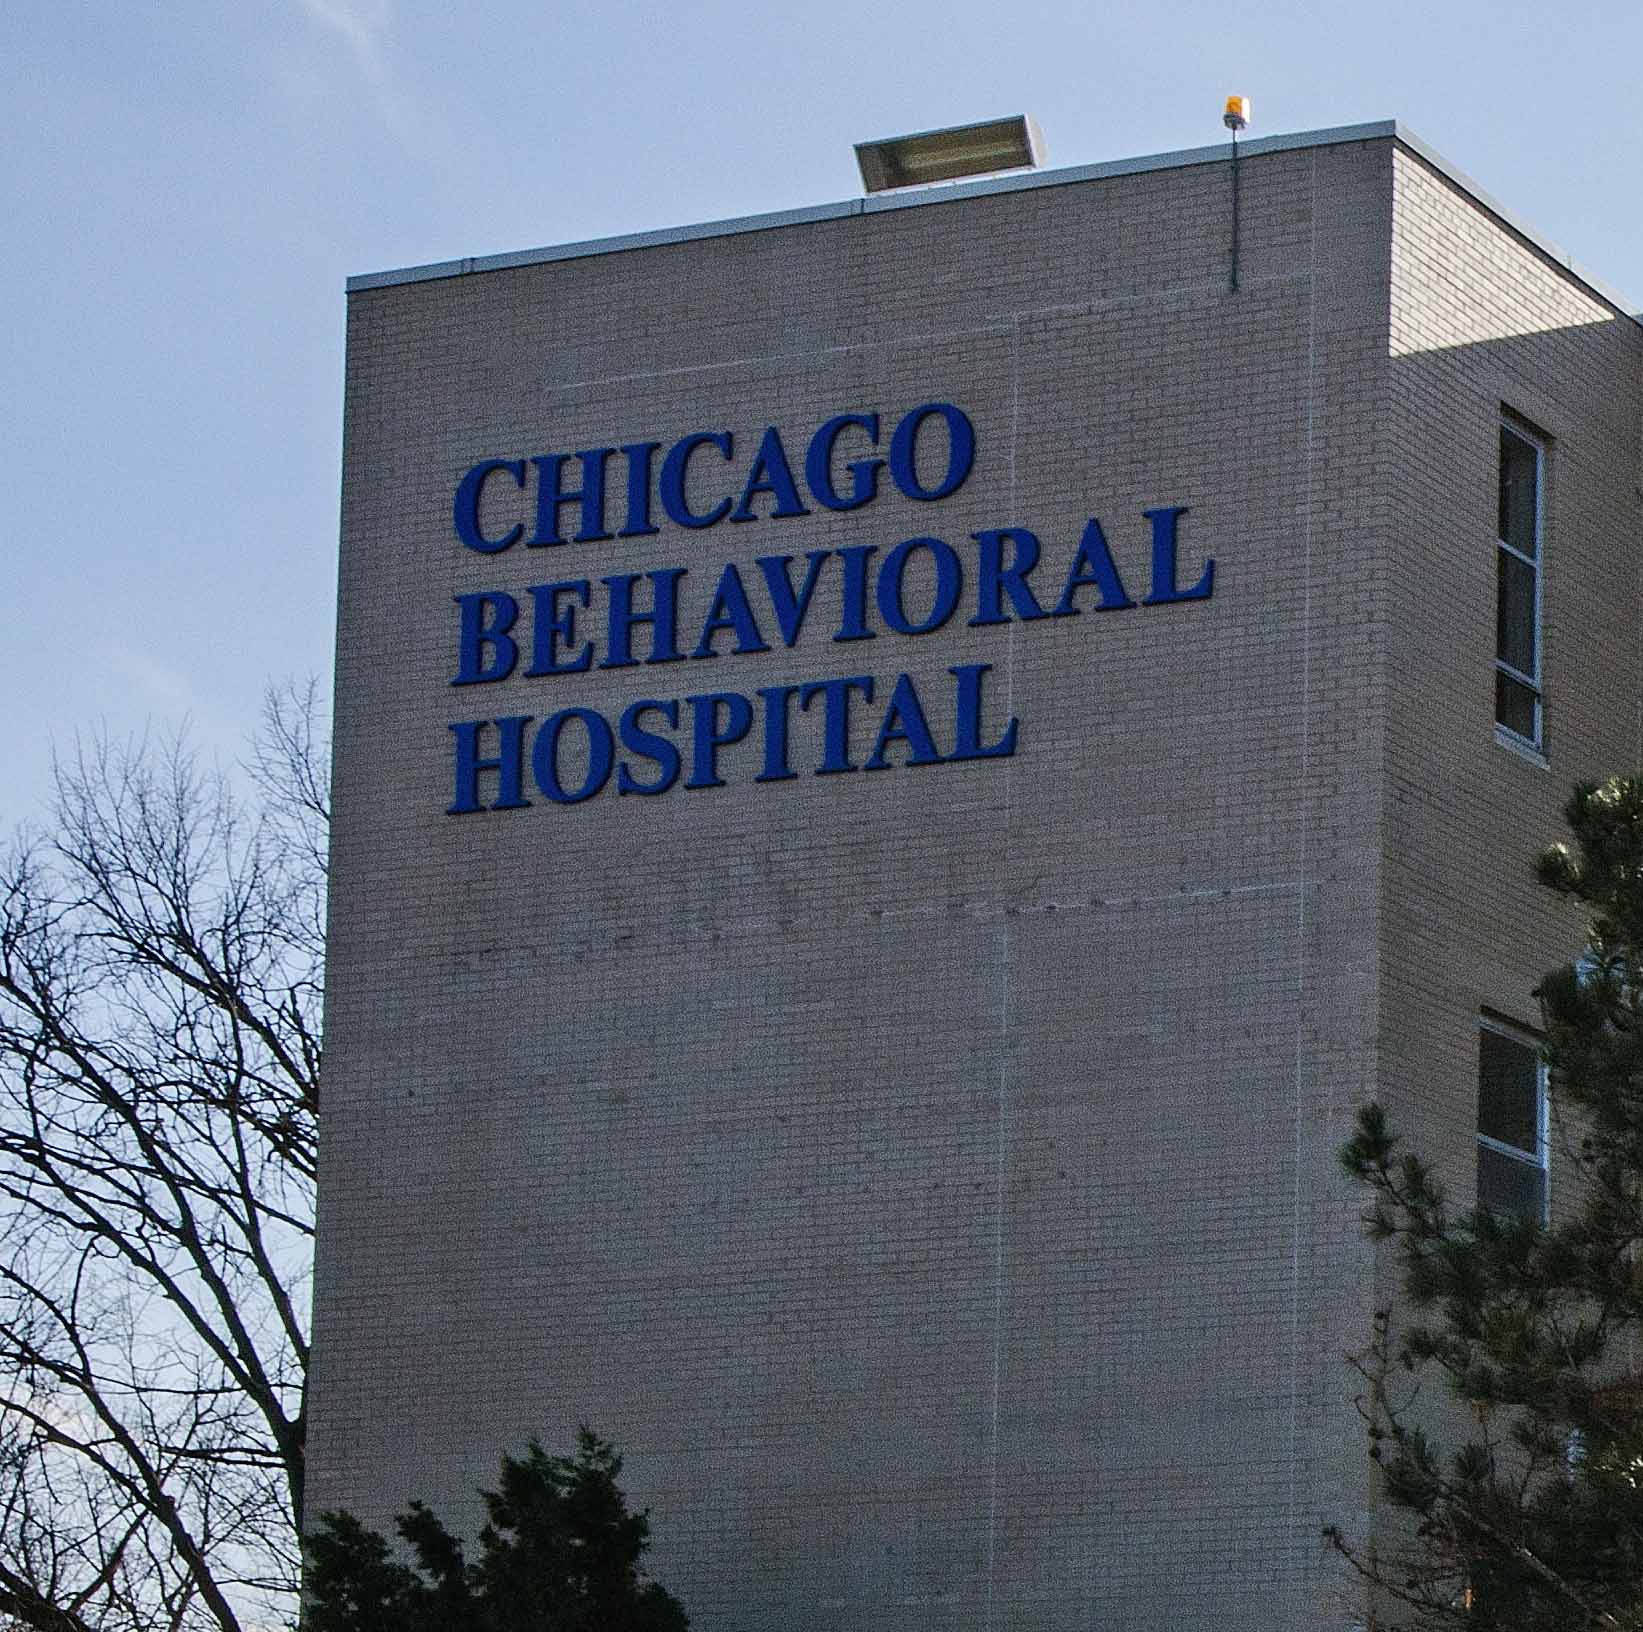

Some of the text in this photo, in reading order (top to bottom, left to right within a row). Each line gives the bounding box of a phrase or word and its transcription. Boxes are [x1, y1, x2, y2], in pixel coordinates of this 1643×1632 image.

[452, 401, 976, 553] CHICAGO
[450, 506, 1215, 686] BEHAVIORAL
[445, 663, 1019, 816] HOSPITAL
